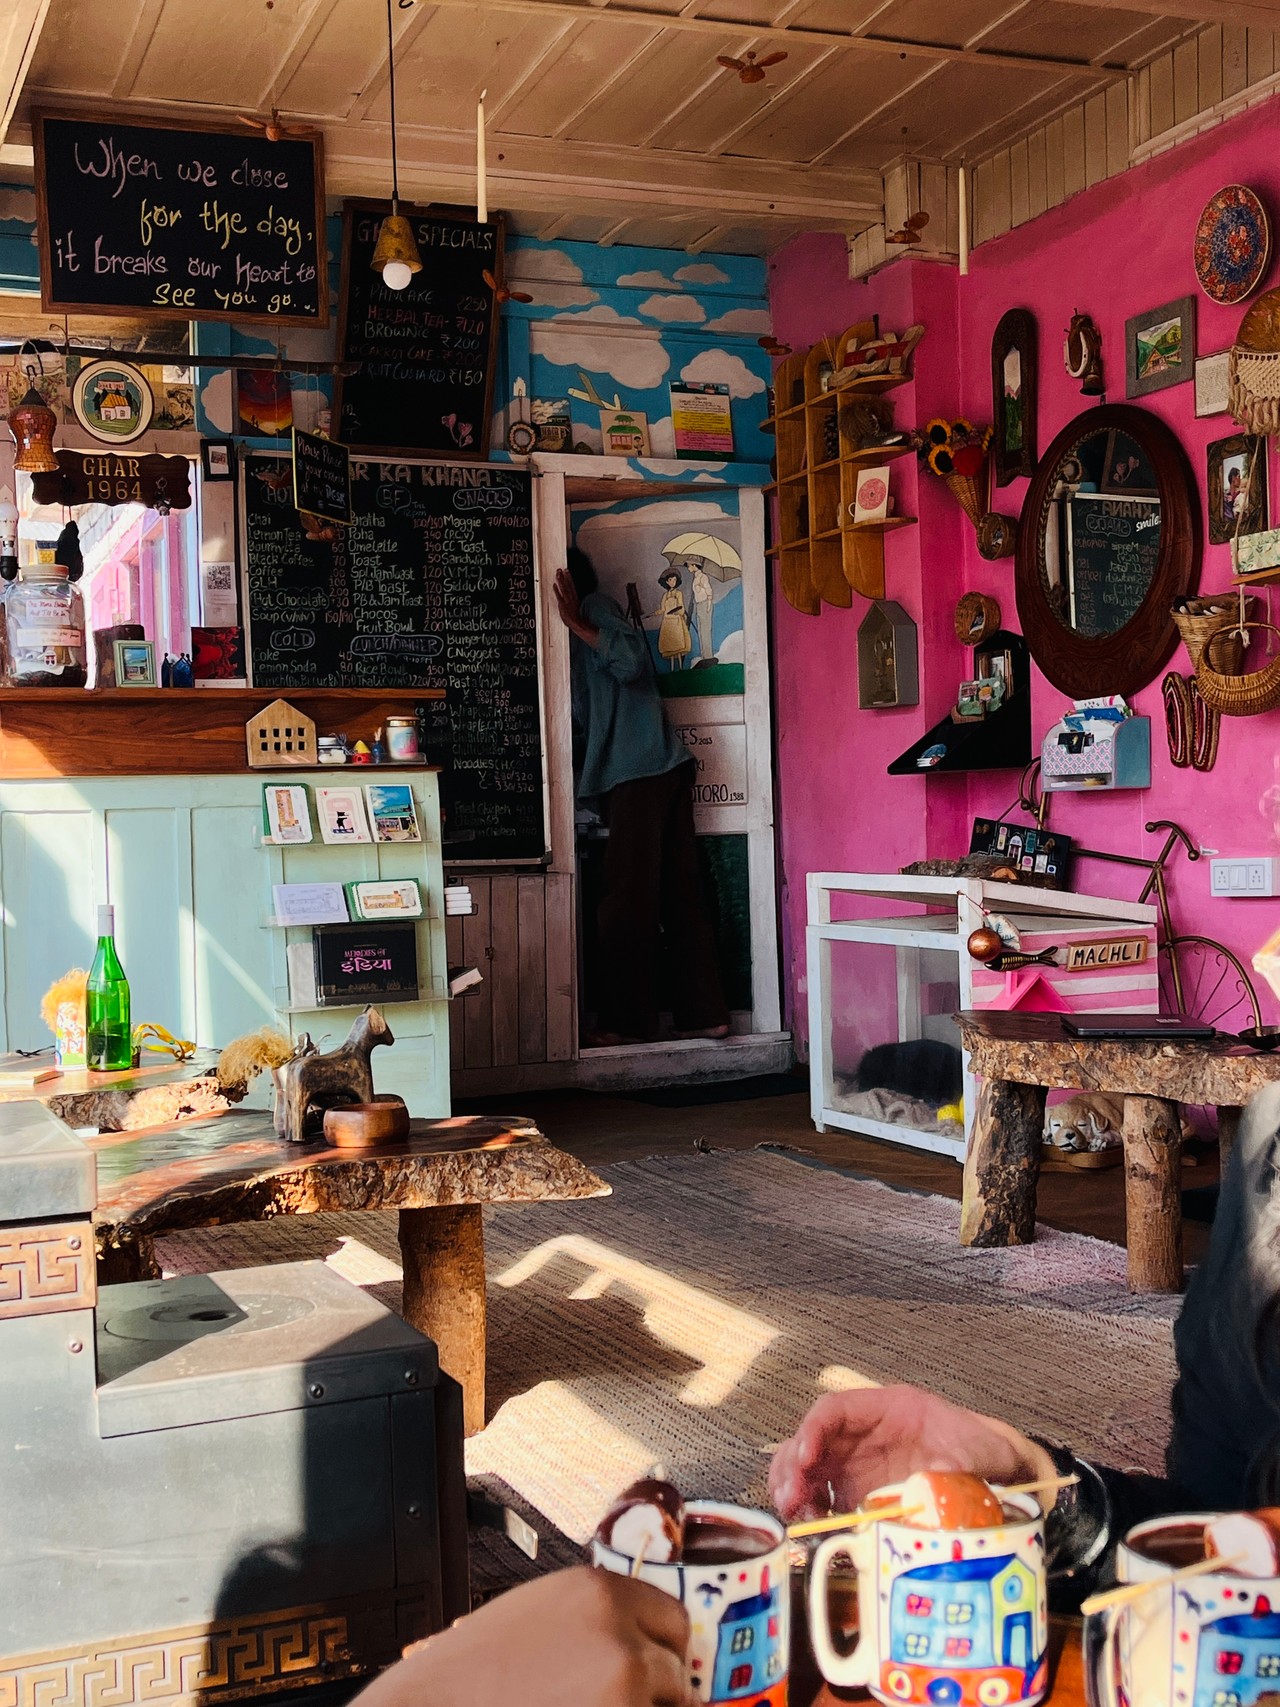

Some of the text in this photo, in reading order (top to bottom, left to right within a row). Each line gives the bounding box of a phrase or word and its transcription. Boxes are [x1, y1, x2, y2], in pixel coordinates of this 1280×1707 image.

[74, 138, 289, 198] When we close
[139, 198, 182, 246] for
[199, 200, 247, 250] the
[418, 225, 493, 254] SPECIALS
[55, 231, 317, 291] it breaks our heart to
[214, 287, 257, 310] you
[367, 305, 418, 328] HERBAL
[83, 458, 142, 478] GHAR
[379, 464, 412, 484] KA
[421, 467, 492, 488] KHANA
[87, 480, 144, 501] 1964
[456, 489, 510, 507] SNACKS
[248, 513, 271, 526] Chai
[443, 514, 482, 534] Maggie
[248, 526, 284, 542] Lemon
[348, 527, 375, 541] Poha
[332, 542, 345, 554] 60
[348, 539, 399, 554] Omelette
[457, 540, 488, 553] Toast
[249, 553, 347, 568] Black Coffee 70
[349, 552, 441, 567] Toast 50
[442, 552, 493, 567] Sandwich
[249, 565, 284, 577] Coffee
[422, 565, 443, 580] 120
[378, 580, 411, 595] Toast
[424, 581, 443, 595] 120
[443, 578, 477, 593] Siddu
[254, 592, 275, 607] Hot
[276, 590, 328, 608] Chocolate
[444, 594, 472, 607] Fries
[251, 608, 280, 624] Soup
[353, 607, 399, 622] Chocos
[425, 608, 443, 621] 130
[510, 604, 531, 617] 300
[356, 619, 384, 634] Fruit
[423, 620, 444, 632] 200
[444, 619, 481, 632] Kebab
[274, 632, 314, 648] COLD
[253, 648, 281, 662] Coke
[253, 660, 354, 676] Lemon Soda 80
[355, 662, 378, 677] Rice
[453, 759, 495, 771] Noodles
[1073, 942, 1141, 967] MACHLI
[339, 957, 393, 976] इंडिया
